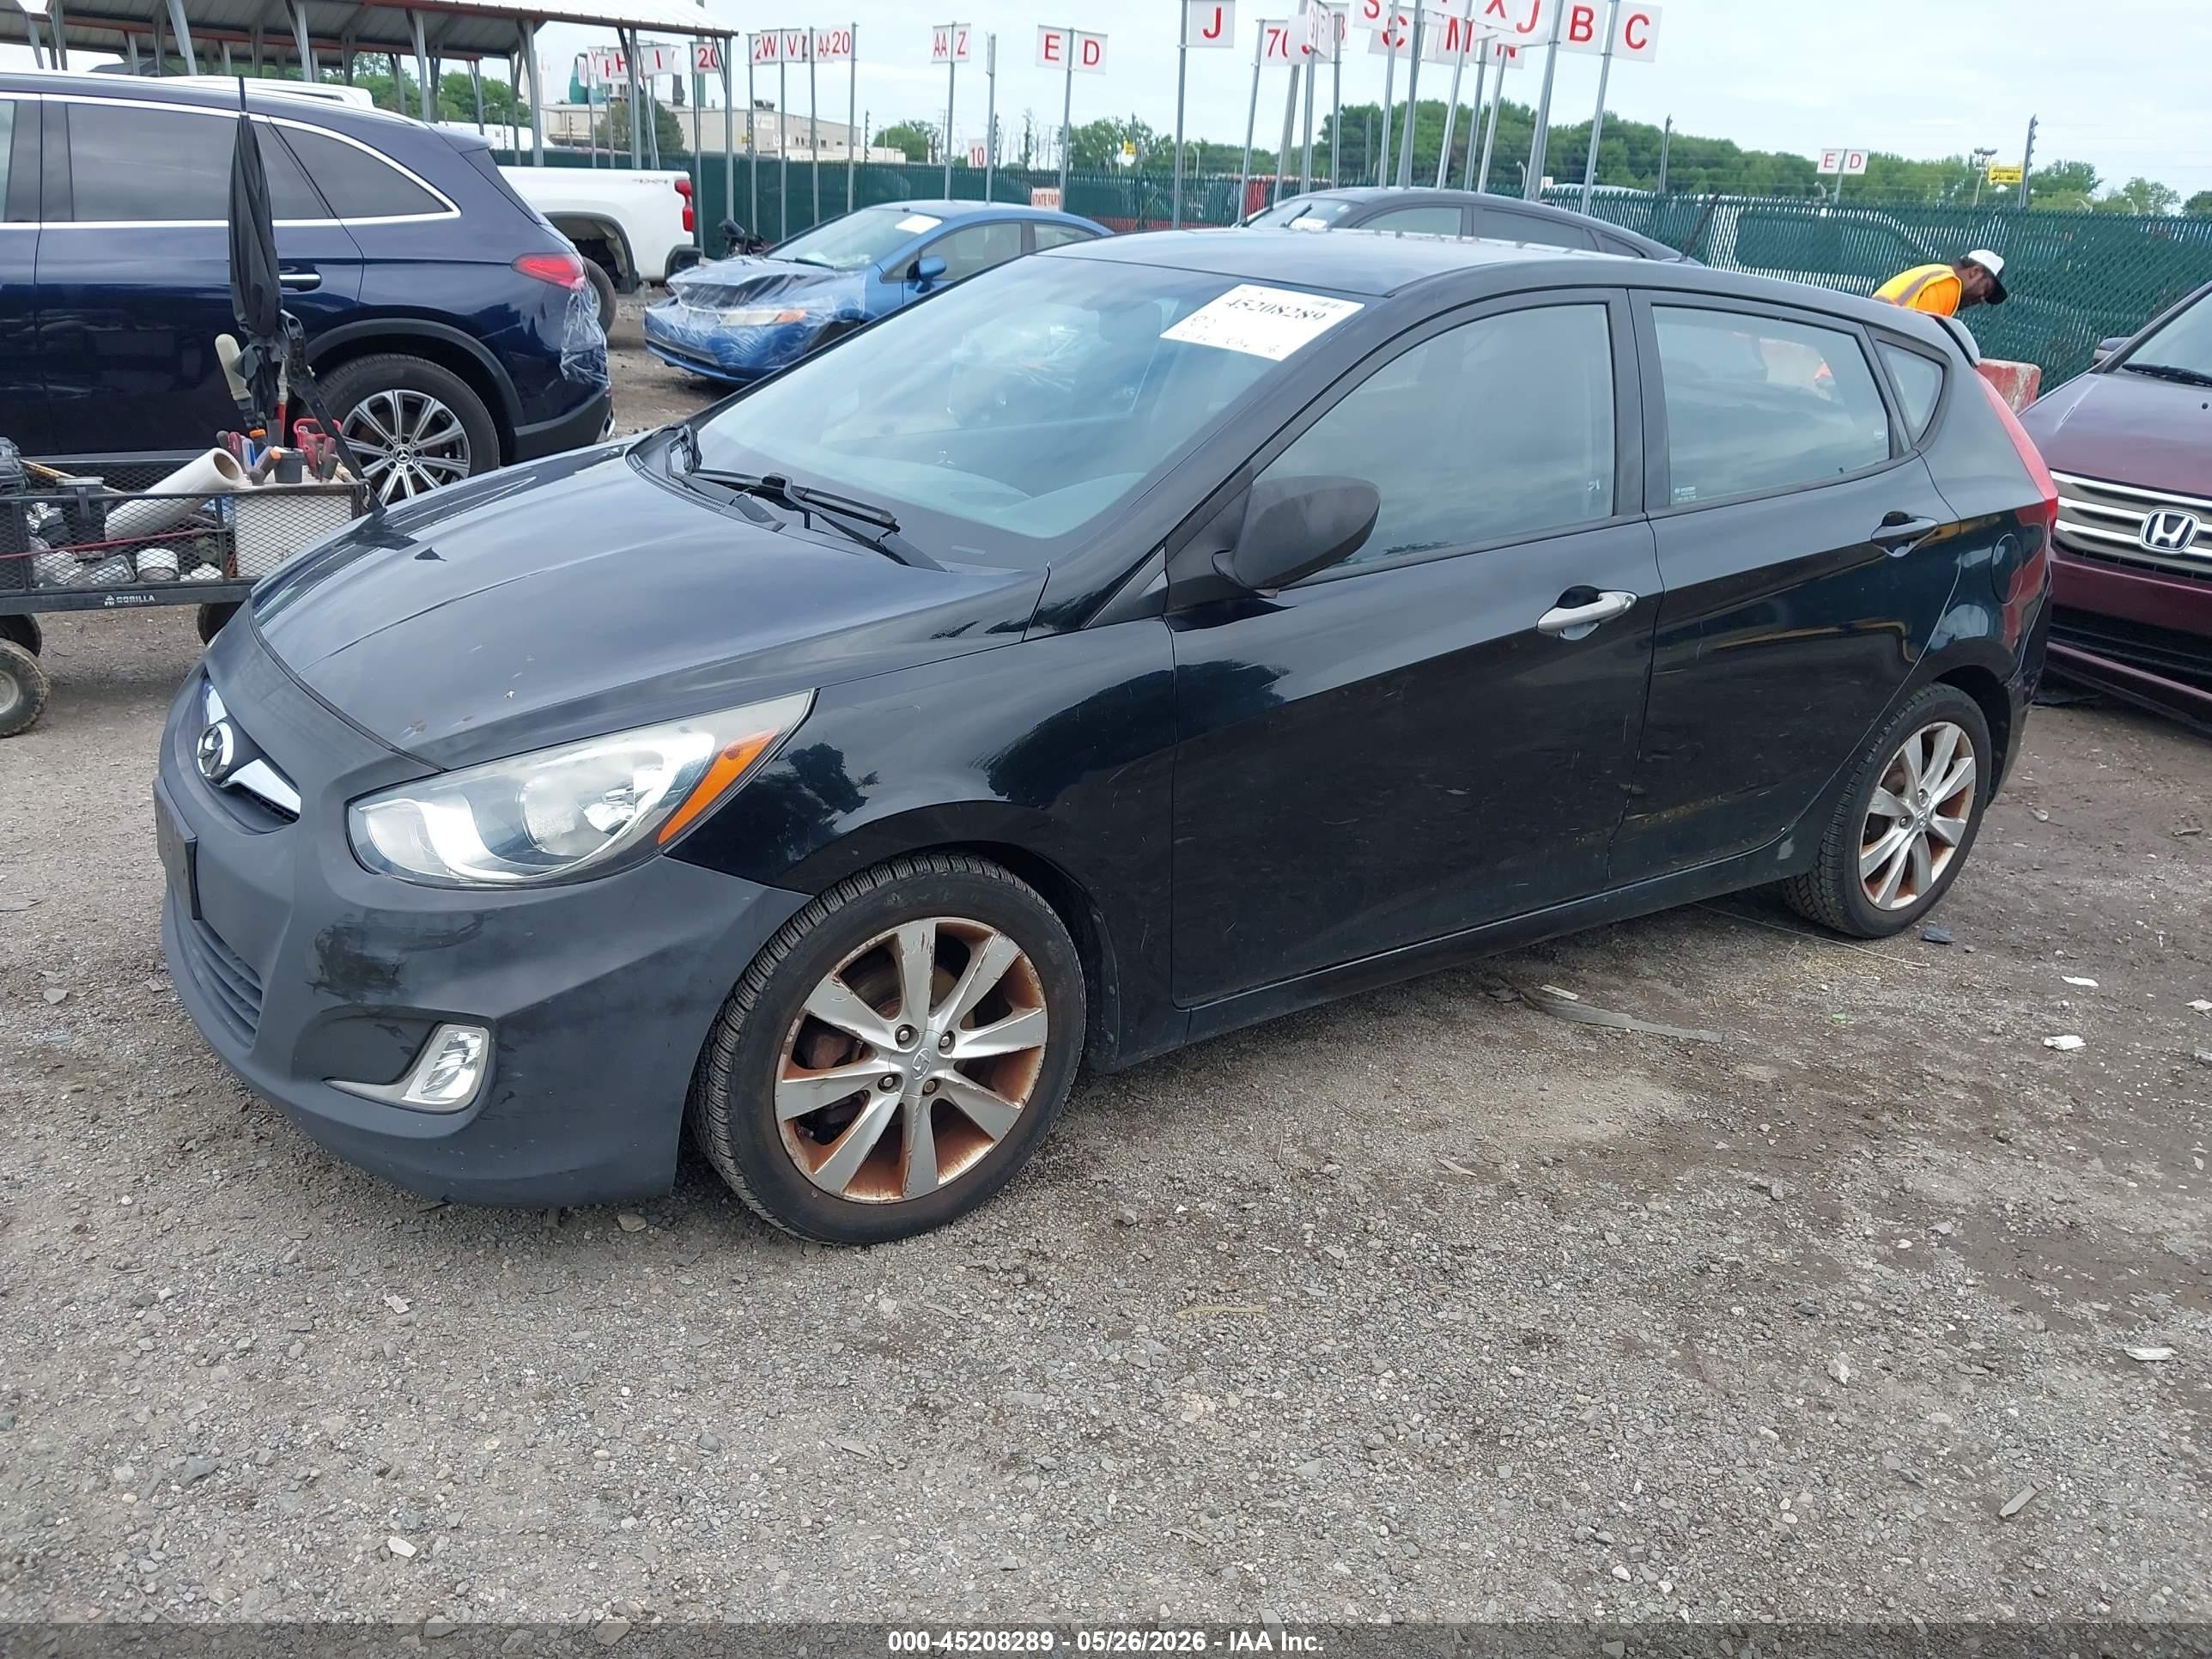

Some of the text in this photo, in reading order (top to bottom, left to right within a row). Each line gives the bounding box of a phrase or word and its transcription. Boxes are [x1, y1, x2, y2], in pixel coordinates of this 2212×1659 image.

[1202, 6, 1221, 39] J
[1382, 15, 1407, 48] C
[1569, 5, 1594, 42] B
[1625, 14, 1650, 50] C
[762, 35, 777, 57] W
[787, 34, 797, 57] V
[831, 31, 851, 53] 20
[957, 31, 966, 55] Z
[1044, 33, 1060, 61] E
[1083, 40, 1100, 65] D
[970, 147, 985, 166] 10
[1824, 153, 1836, 168] E
[1849, 154, 1862, 169] D
